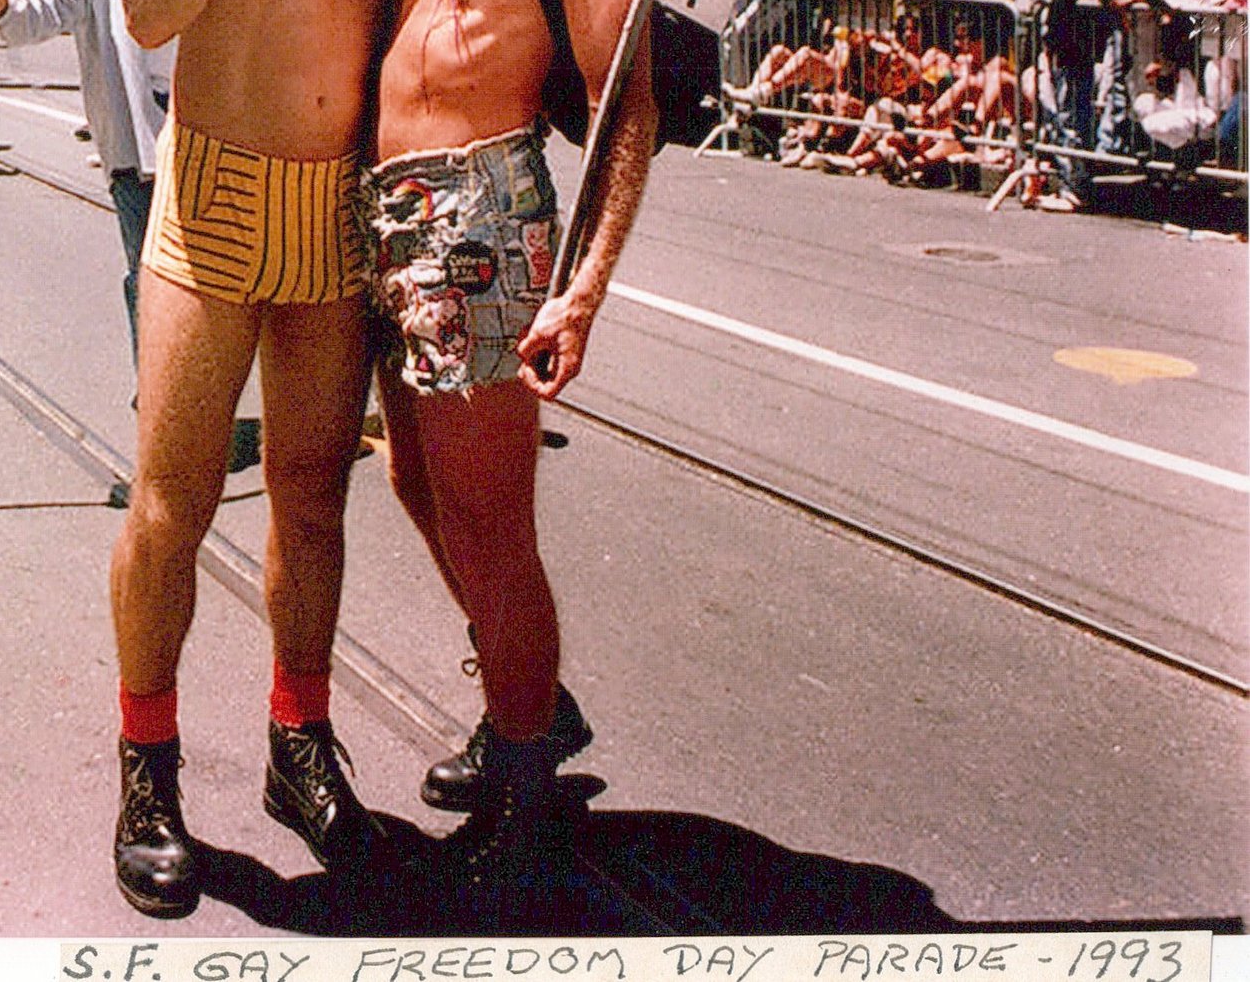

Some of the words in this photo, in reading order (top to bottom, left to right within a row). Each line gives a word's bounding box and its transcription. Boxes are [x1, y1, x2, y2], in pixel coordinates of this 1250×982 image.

[62, 944, 161, 981] S.F.
[193, 951, 310, 982] GAY
[353, 947, 626, 982] FREEDOM
[663, 943, 774, 977] DAY
[814, 941, 1018, 981] PARADE
